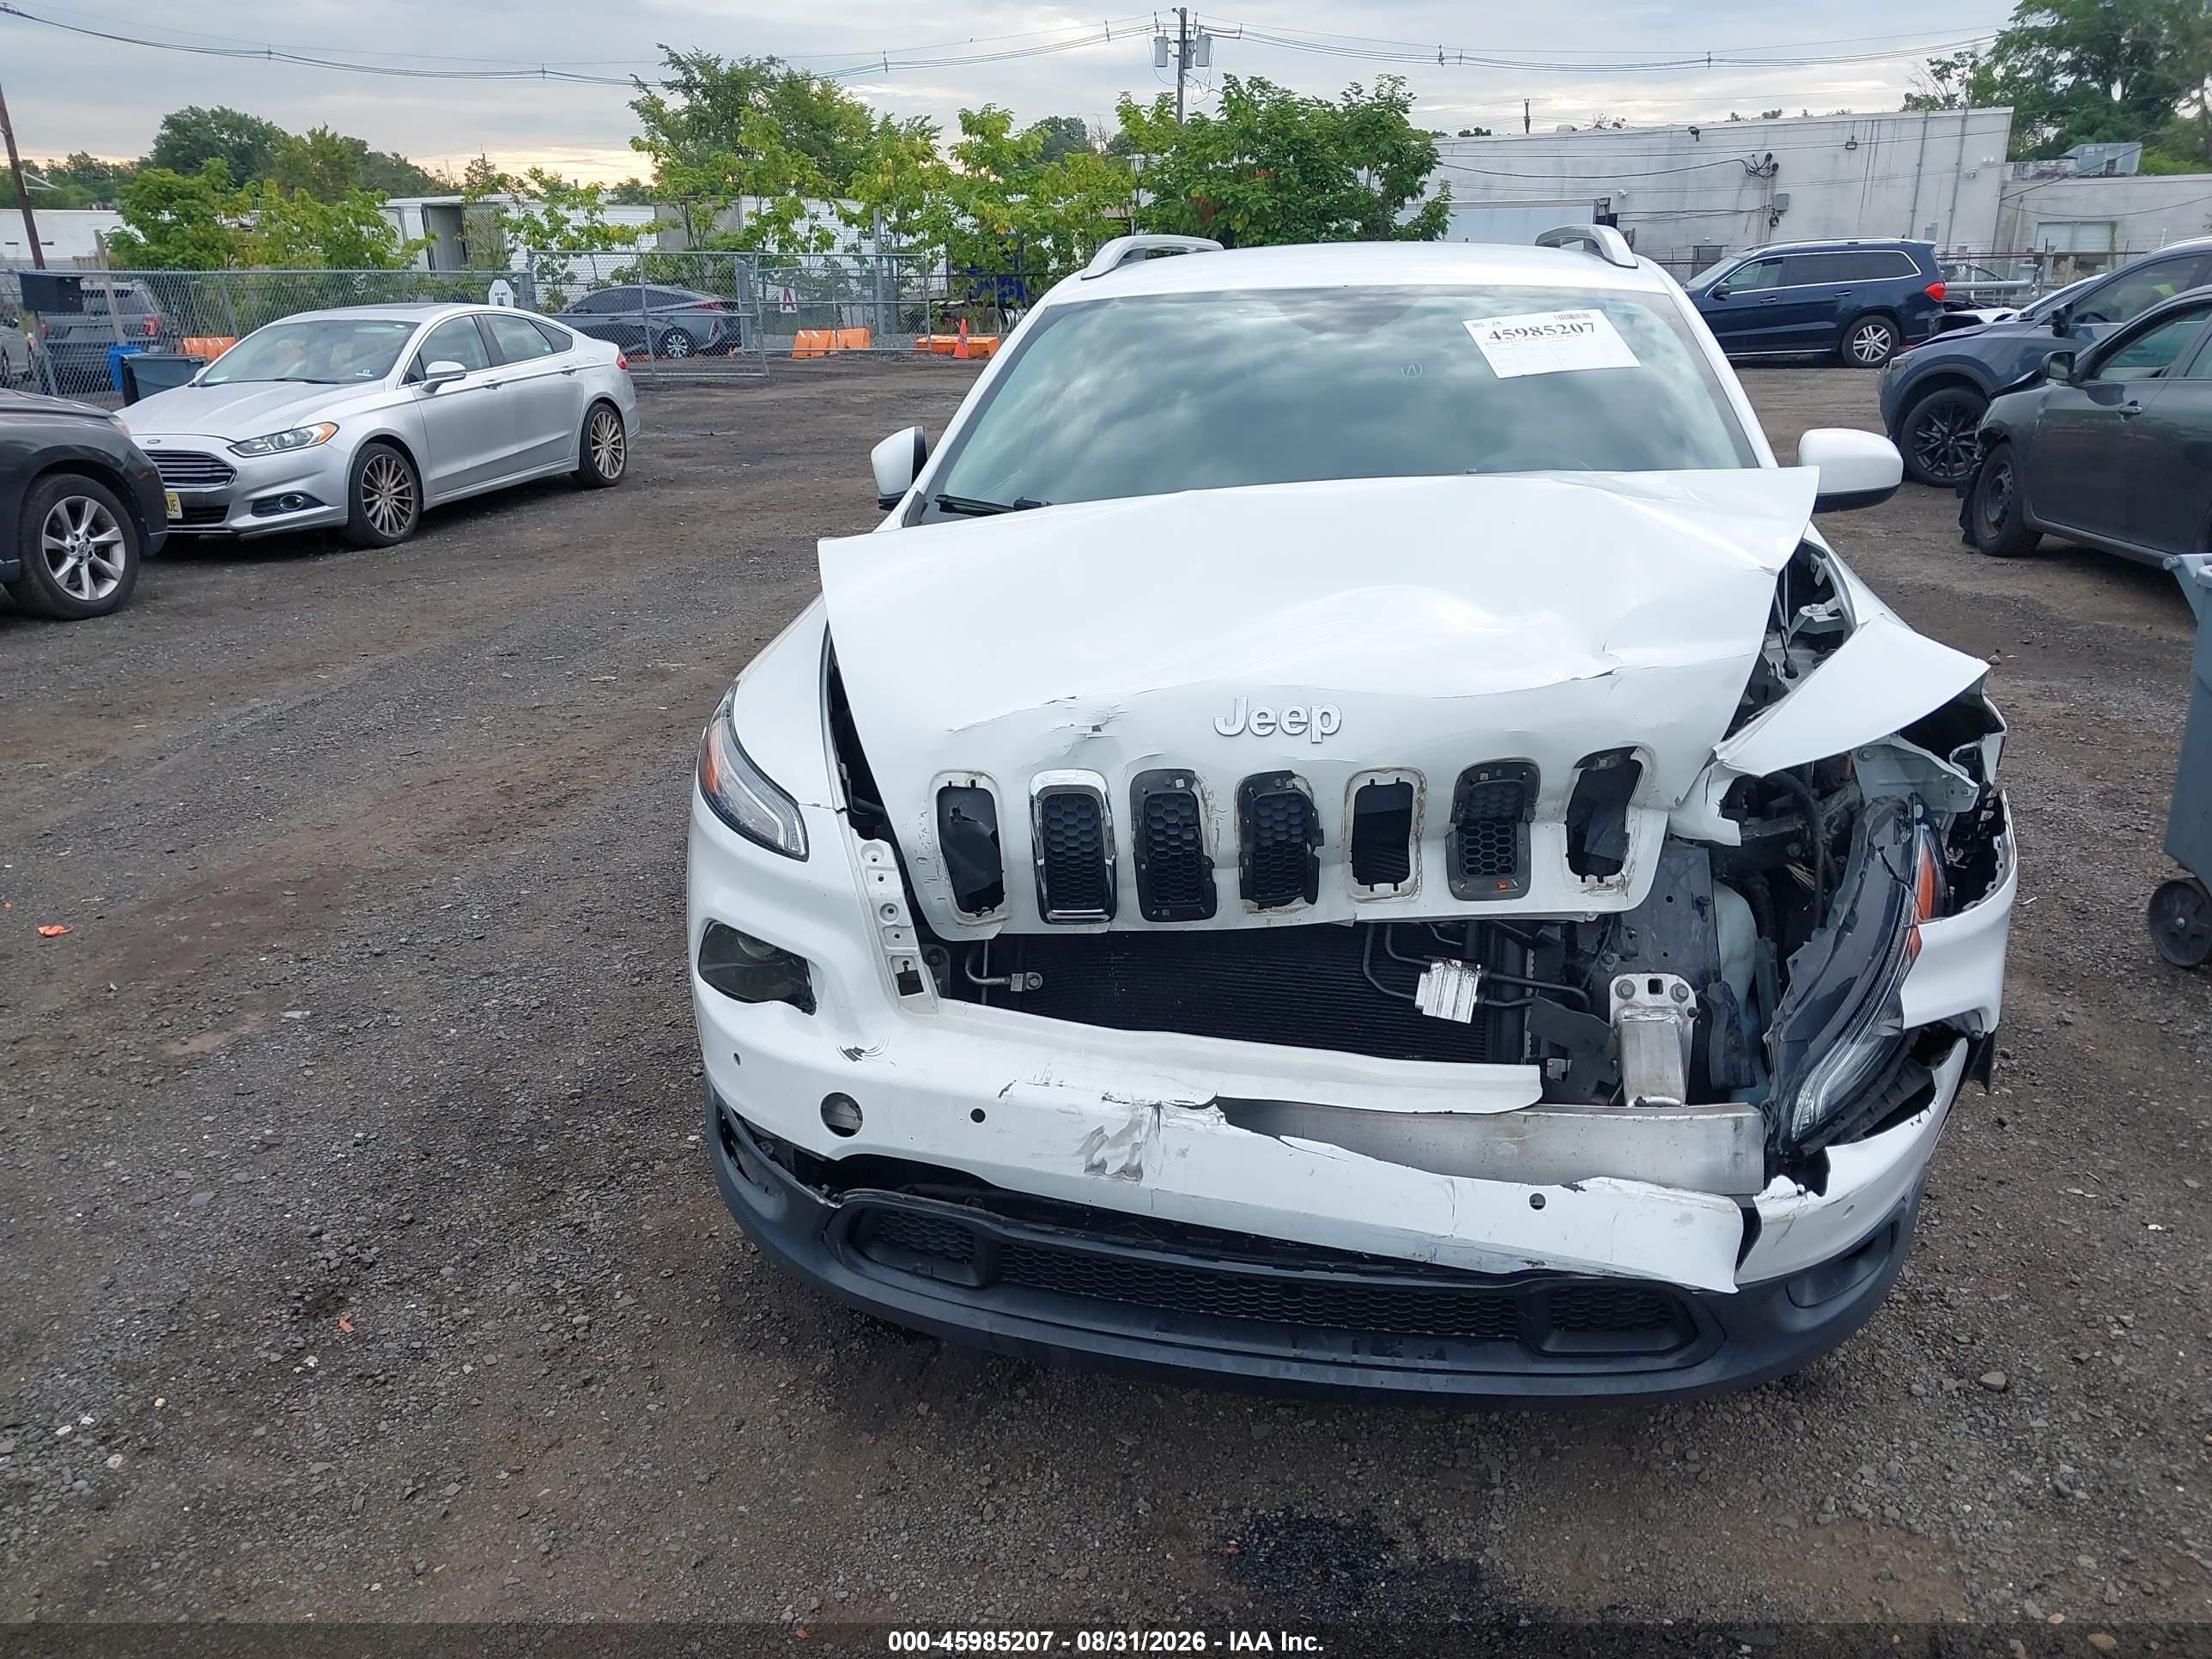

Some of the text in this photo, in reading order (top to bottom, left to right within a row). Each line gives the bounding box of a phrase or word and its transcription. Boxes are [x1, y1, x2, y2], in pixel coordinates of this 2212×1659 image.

[782, 288, 796, 311] A
[1490, 322, 1595, 341] 45985207
[1213, 696, 1341, 744] Jeep
